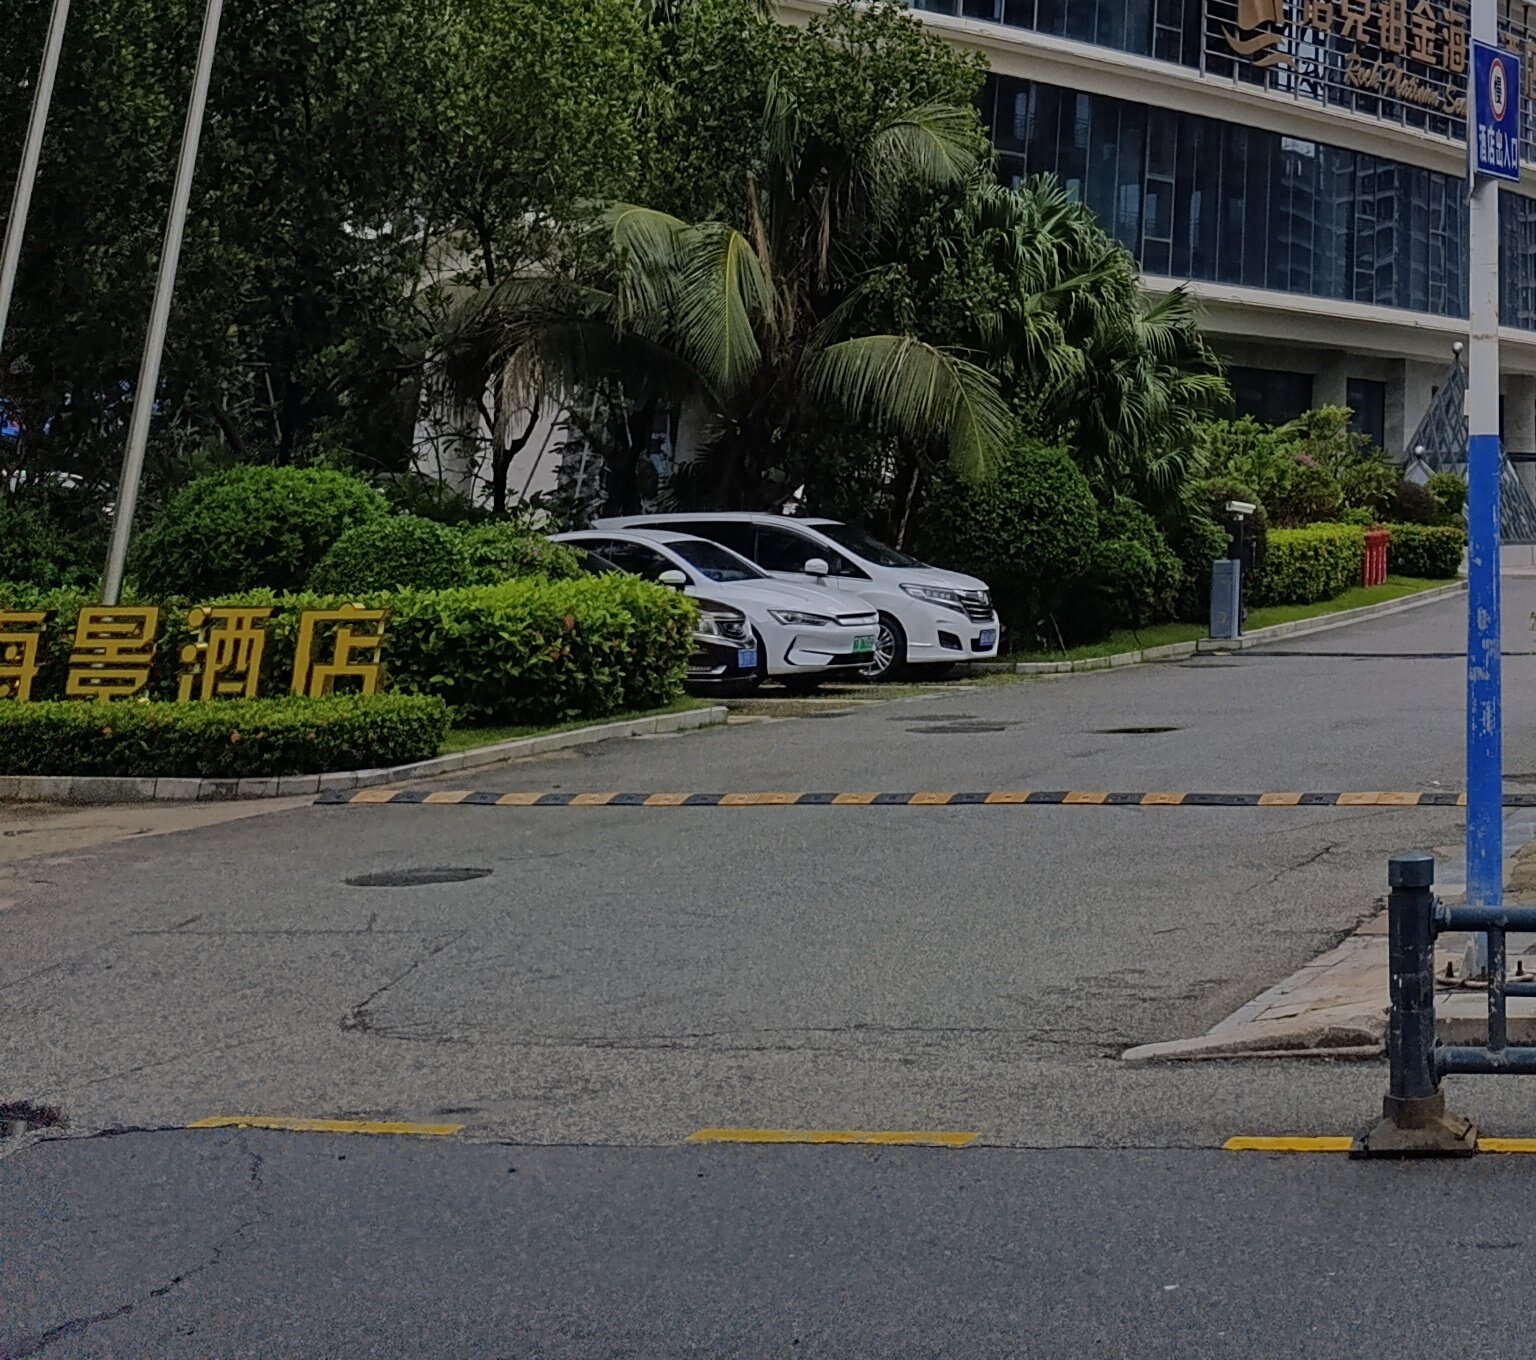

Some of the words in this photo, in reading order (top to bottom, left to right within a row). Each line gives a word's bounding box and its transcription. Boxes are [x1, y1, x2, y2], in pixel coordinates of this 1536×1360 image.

[1478, 124, 1518, 170] 酒店出入口
